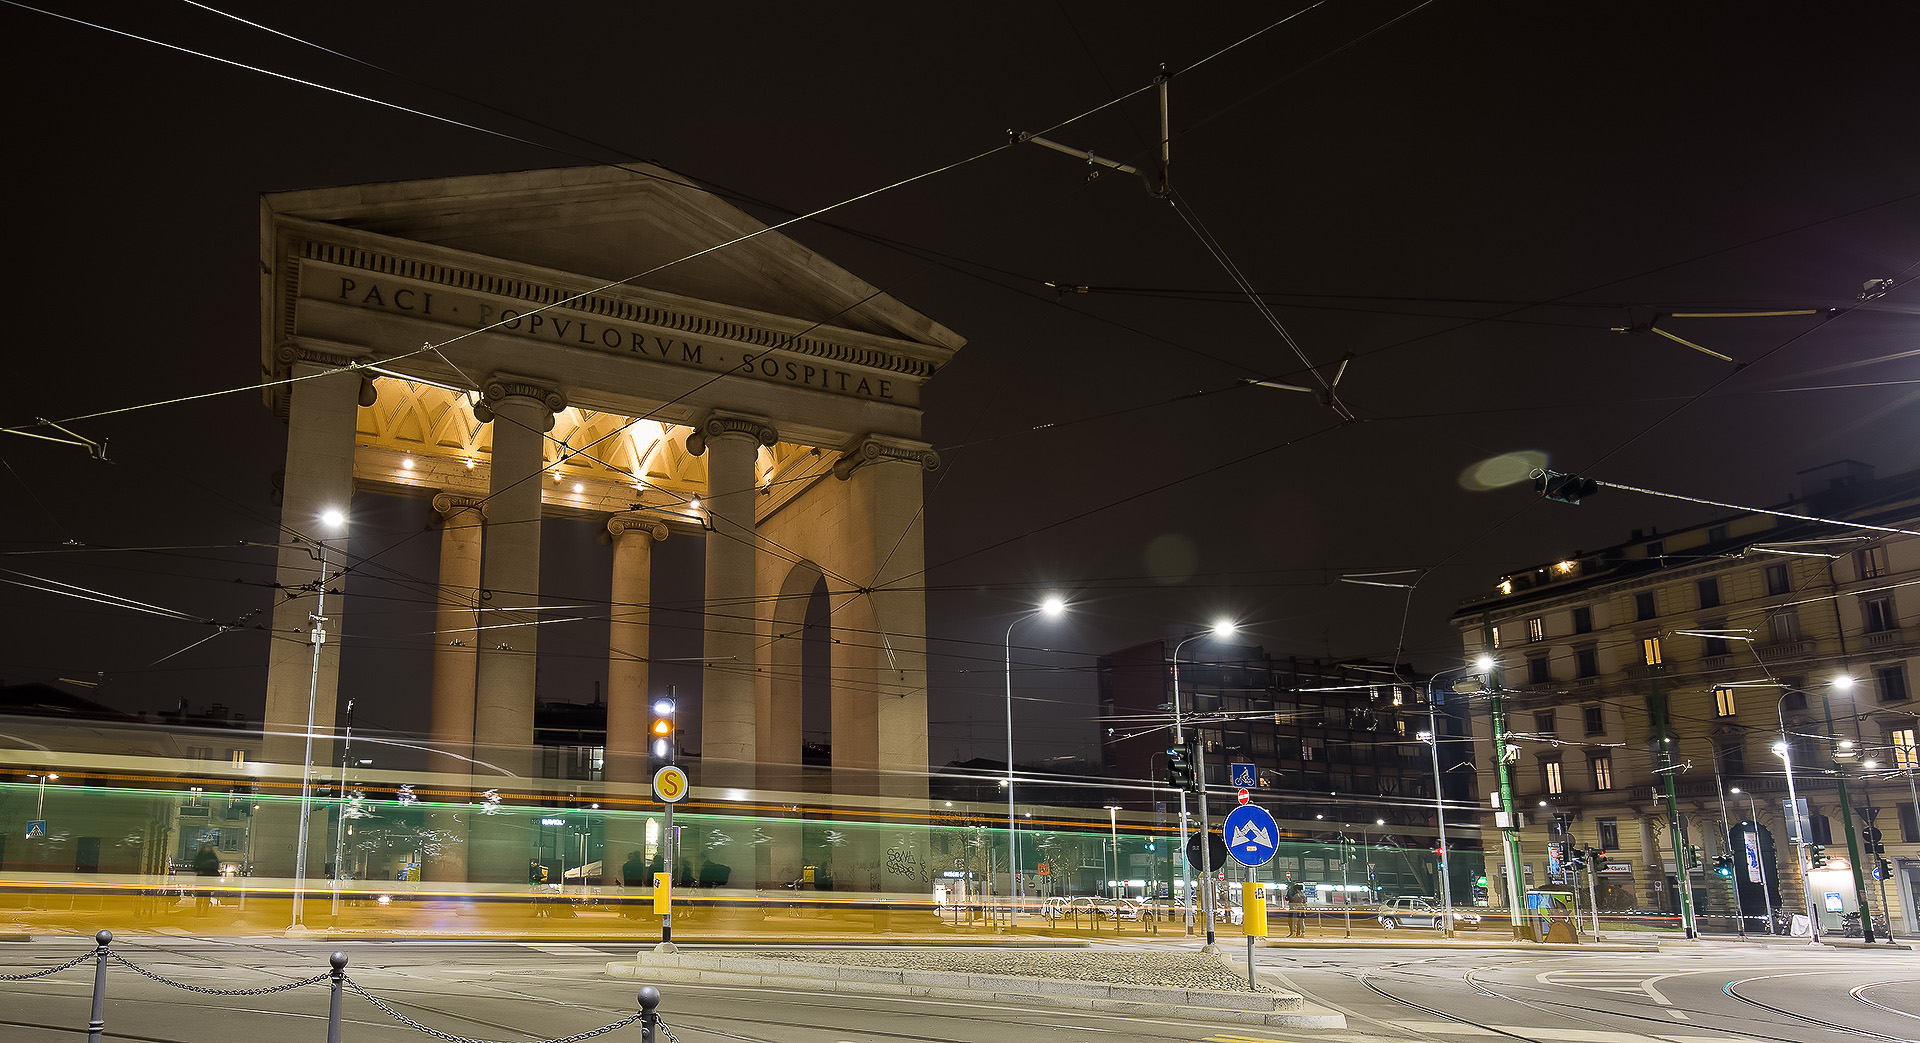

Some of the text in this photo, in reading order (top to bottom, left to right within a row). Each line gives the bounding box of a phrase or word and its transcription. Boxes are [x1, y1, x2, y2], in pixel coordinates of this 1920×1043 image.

[339, 277, 894, 399] PACI POPVLORVM SOSPITAE
[663, 771, 678, 797] S
